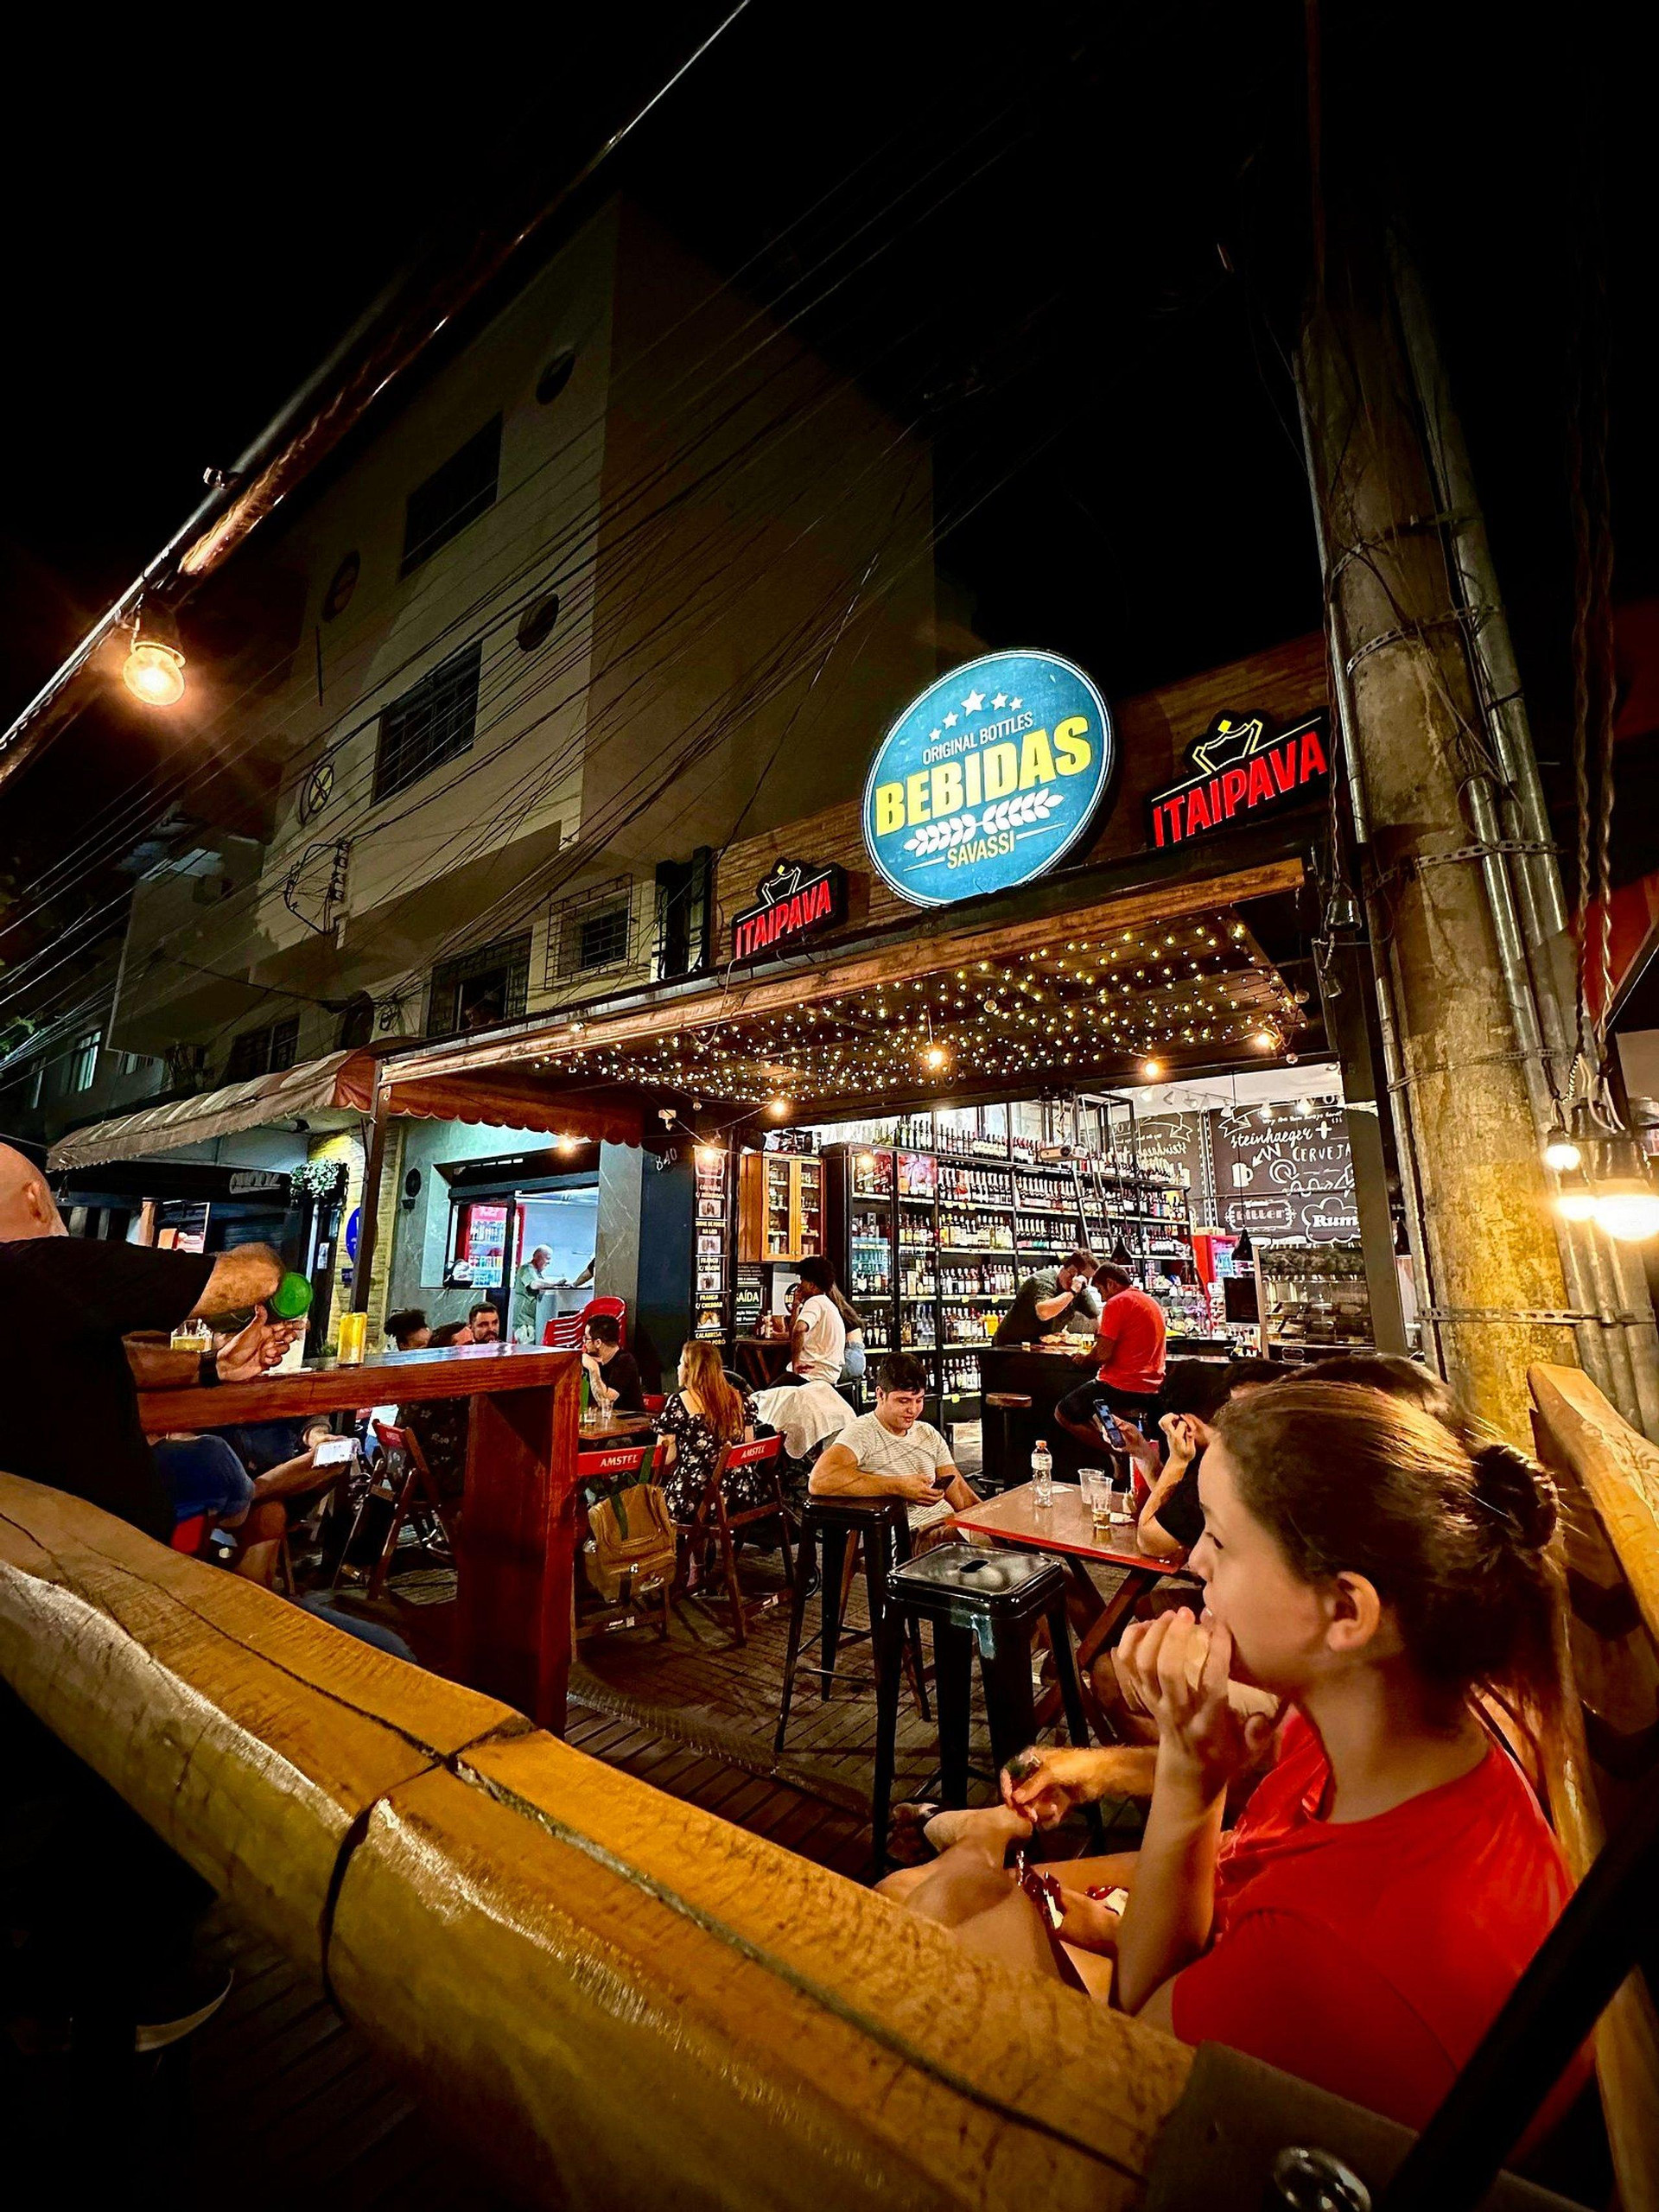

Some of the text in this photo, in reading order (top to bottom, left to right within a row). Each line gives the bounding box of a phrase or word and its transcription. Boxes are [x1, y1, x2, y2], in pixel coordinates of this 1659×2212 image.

[922, 711, 1033, 766] ORIGINAL BOTTLES
[875, 716, 1092, 837] BEBIDAS
[1153, 731, 1328, 848] ITAIPAVA
[947, 830, 1016, 869] SAVASSI
[736, 880, 832, 959] ITAIPAVA
[1292, 1142, 1352, 1162] CERVEJA
[1313, 1214, 1359, 1227] Rum
[600, 1454, 639, 1467] AMSTEL
[741, 1444, 766, 1459] AMSTEL
